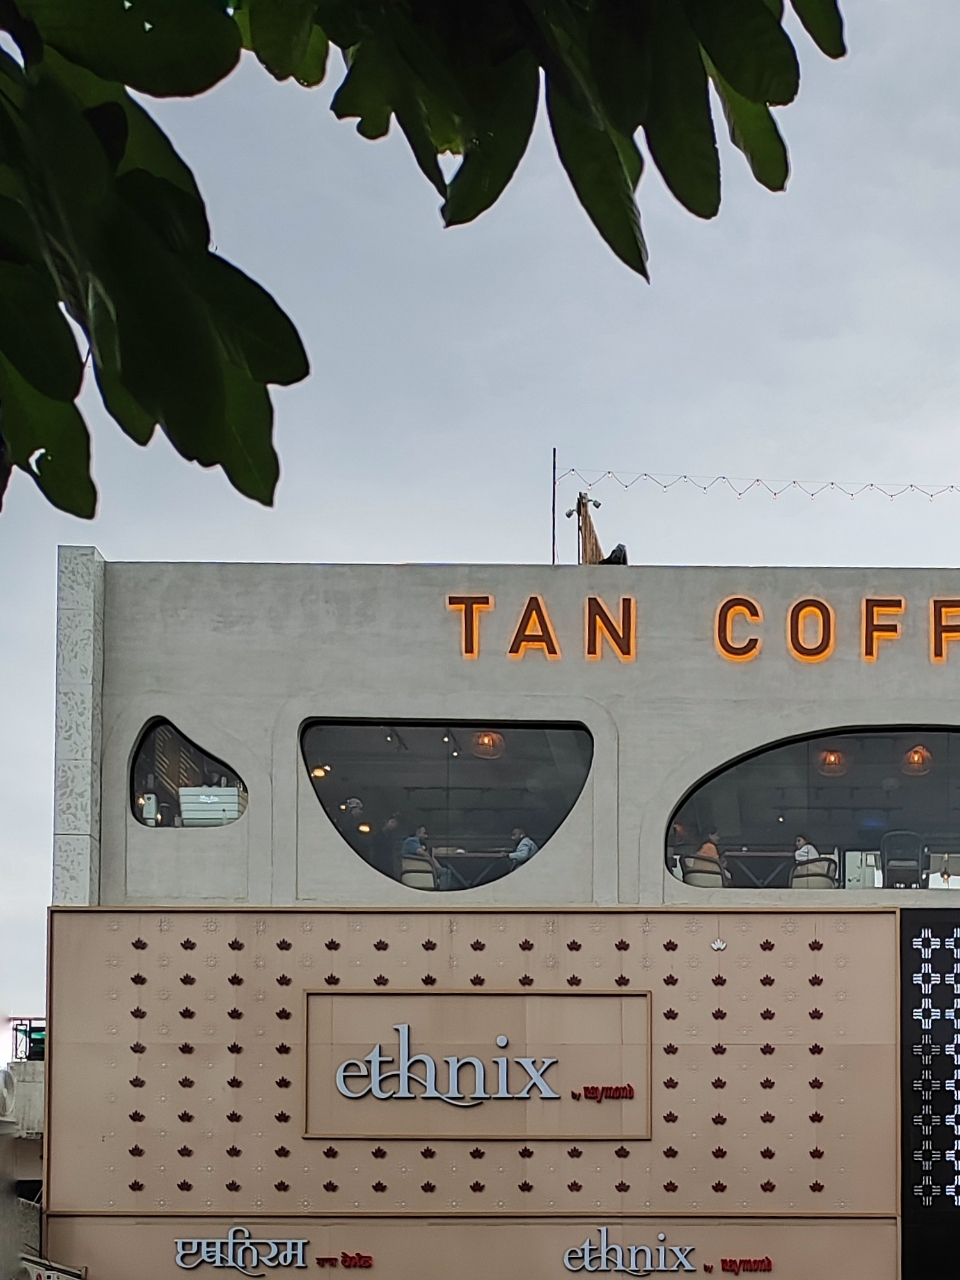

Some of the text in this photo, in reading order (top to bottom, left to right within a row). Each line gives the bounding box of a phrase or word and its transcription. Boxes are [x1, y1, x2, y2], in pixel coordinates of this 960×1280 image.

[448, 595, 634, 658] TAN
[335, 1023, 561, 1106] ethnix
[571, 1090, 581, 1101] by
[563, 1226, 696, 1276] ethnix
